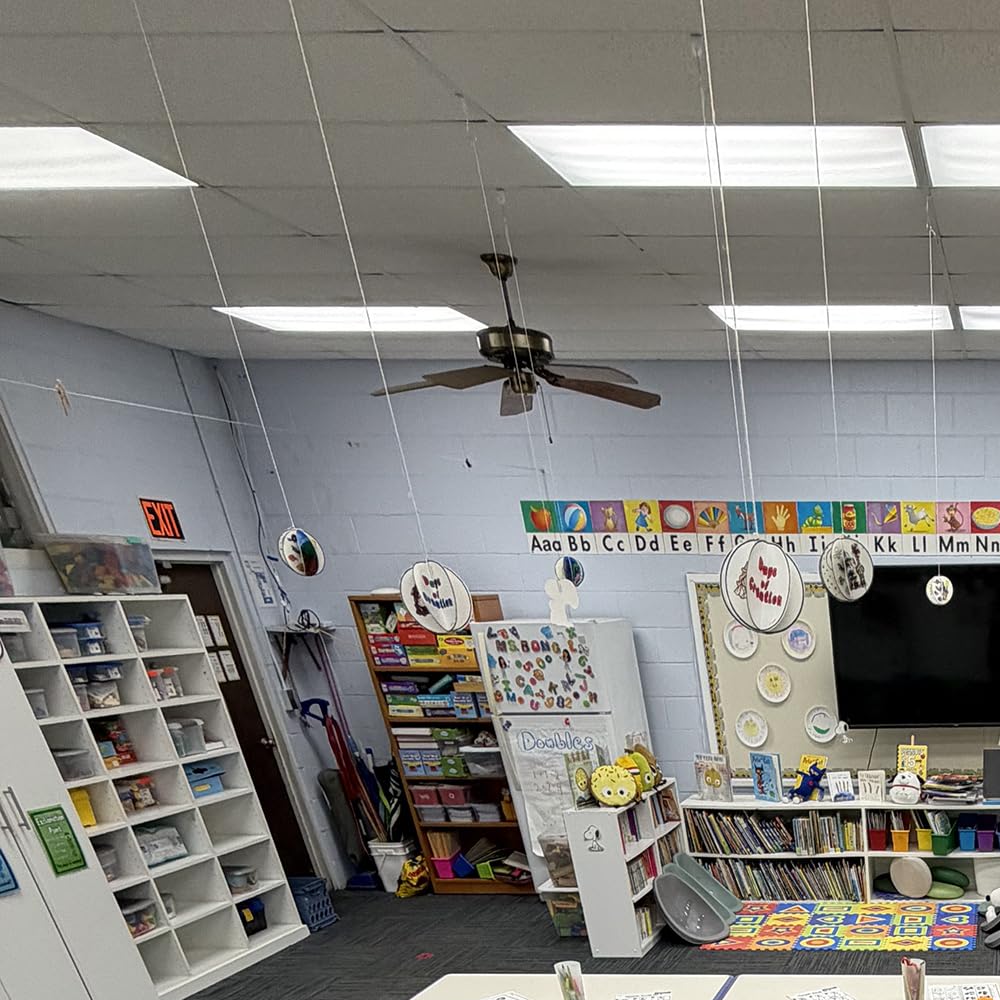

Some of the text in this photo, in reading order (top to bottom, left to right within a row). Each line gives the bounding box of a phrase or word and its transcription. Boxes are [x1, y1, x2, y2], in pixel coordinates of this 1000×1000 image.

[142, 501, 181, 538] EXIT
[531, 535, 562, 552] Aaa
[568, 535, 591, 552] Bb
[602, 535, 624, 551] Cc
[635, 535, 659, 551] Dd
[671, 535, 692, 551] Ee
[706, 535, 725, 552] Ff
[874, 536, 897, 552] Kk
[939, 536, 969, 552] Mm
[976, 536, 1000, 552] Nn
[758, 555, 778, 580] Days
[760, 579, 770, 591] of
[521, 730, 595, 752] Doubles
